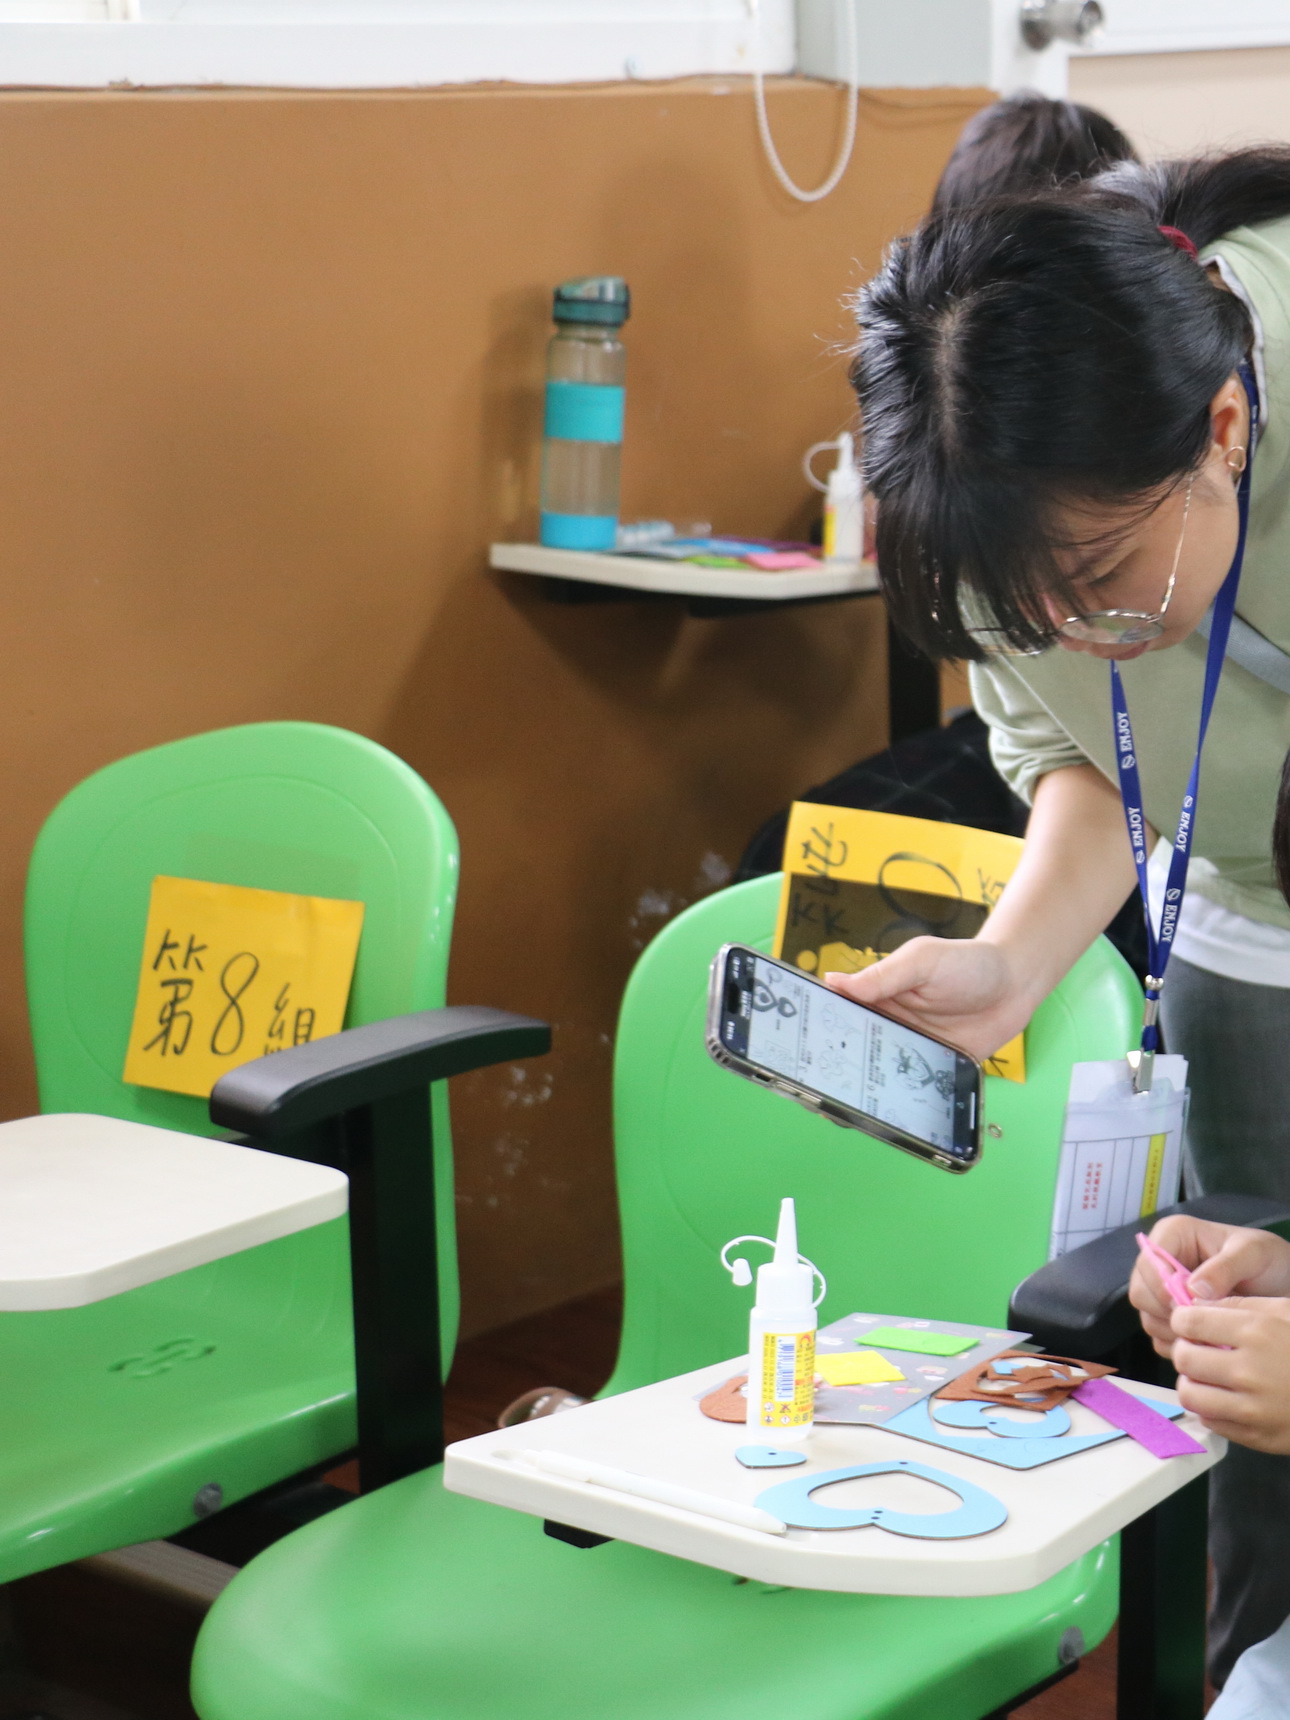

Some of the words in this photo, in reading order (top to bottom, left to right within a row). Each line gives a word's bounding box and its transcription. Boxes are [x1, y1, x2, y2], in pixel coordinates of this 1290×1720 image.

[1116, 712, 1133, 752] ENJOY
[1128, 807, 1144, 847] ENJOY
[1175, 811, 1191, 852] ENJOY
[1161, 904, 1179, 943] ENJOY
